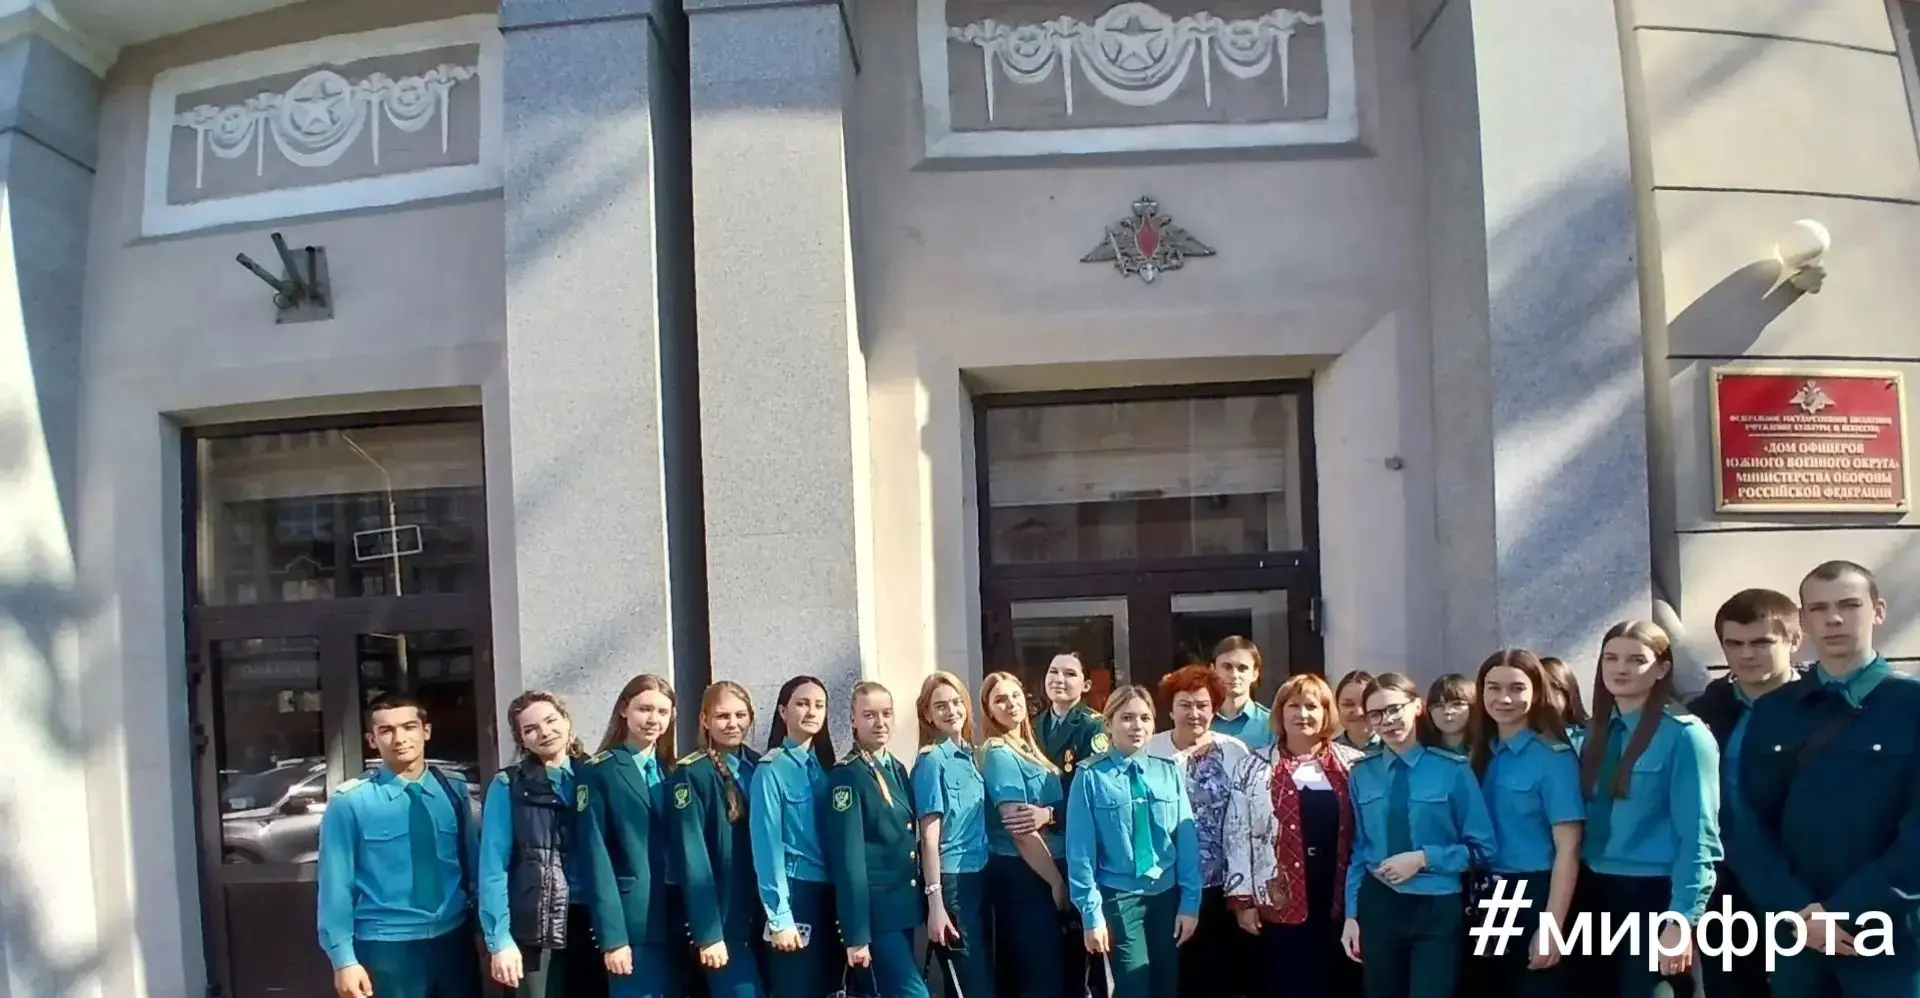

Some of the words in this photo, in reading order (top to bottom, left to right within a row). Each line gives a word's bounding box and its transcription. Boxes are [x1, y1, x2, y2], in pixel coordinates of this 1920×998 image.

[1799, 442, 1864, 453] ОФИЦЕРОВ
[1726, 457, 1785, 467] ЮЖНОГО
[1787, 457, 1851, 468] ВОЕННОГО
[1736, 472, 1831, 483] МИНИСТЕРСТВА
[1833, 472, 1892, 484] ОБОРОНЫ
[1738, 485, 1821, 498] РОССИЙСКОЙ
[1823, 486, 1892, 498] ФЕДЕРАЦИИ
